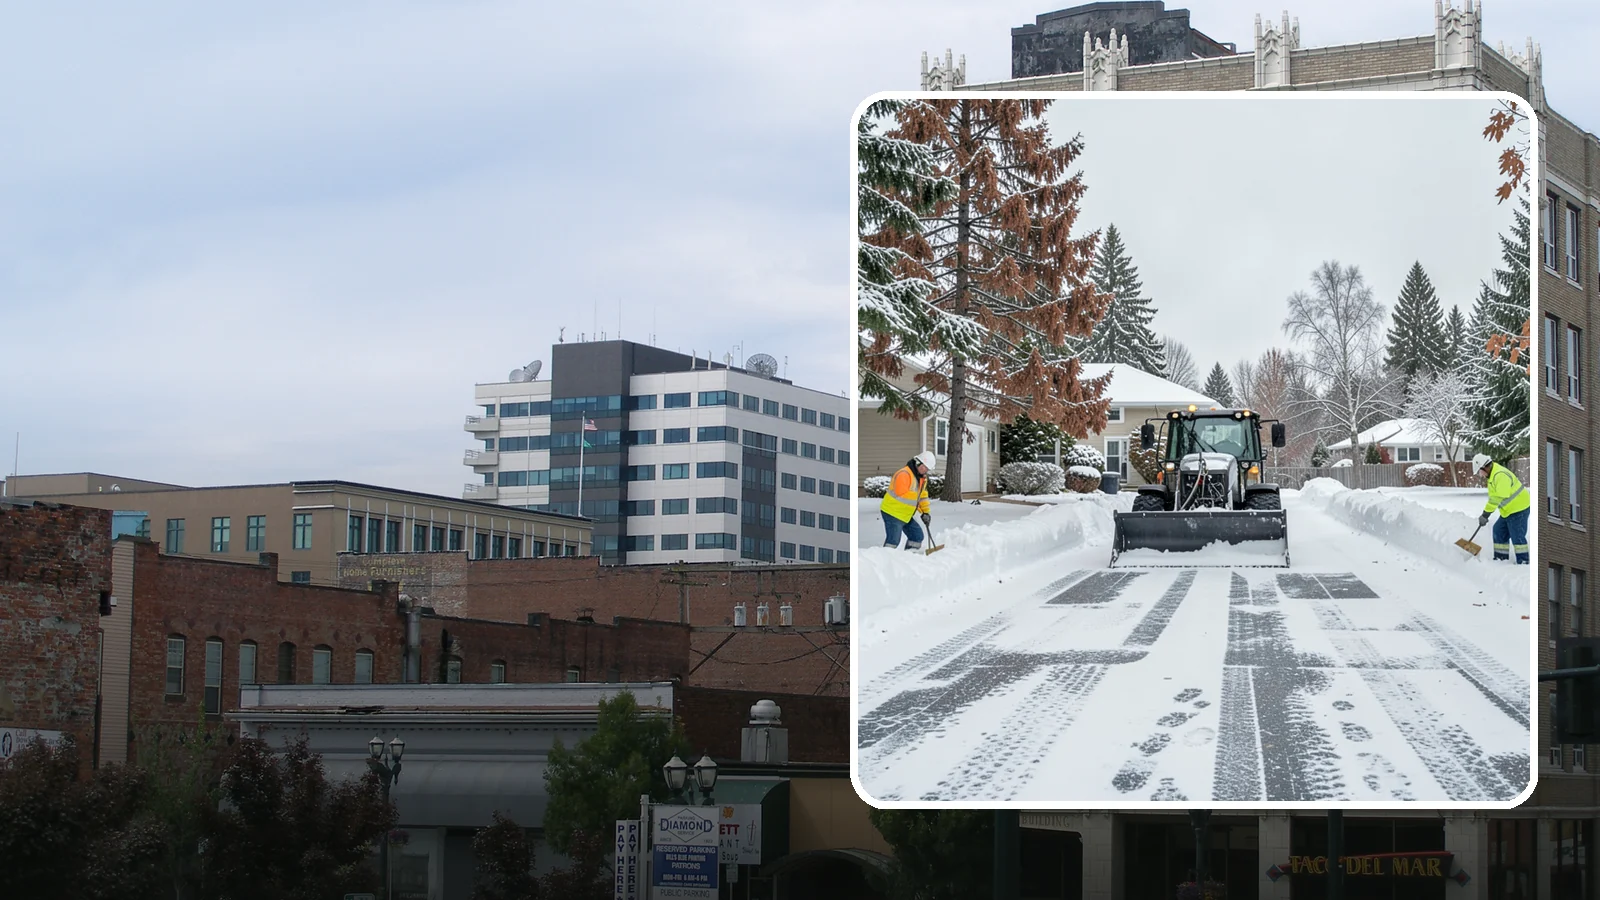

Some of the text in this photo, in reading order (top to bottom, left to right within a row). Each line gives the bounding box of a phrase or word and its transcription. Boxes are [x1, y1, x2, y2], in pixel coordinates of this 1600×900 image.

[343, 566, 427, 577] Home Furnishers
[660, 818, 713, 833] DIAMOND
[1021, 815, 1070, 828] BUILDING
[656, 845, 716, 854] RESERVED PARKING
[616, 825, 625, 893] PAY HERE
[627, 824, 637, 893] PAY HERE
[721, 851, 739, 861] Soup
[671, 862, 701, 870] PATRONS
[1289, 856, 1442, 877] TAC DEL MAR
[660, 889, 710, 898] PUBLIC PARKING
